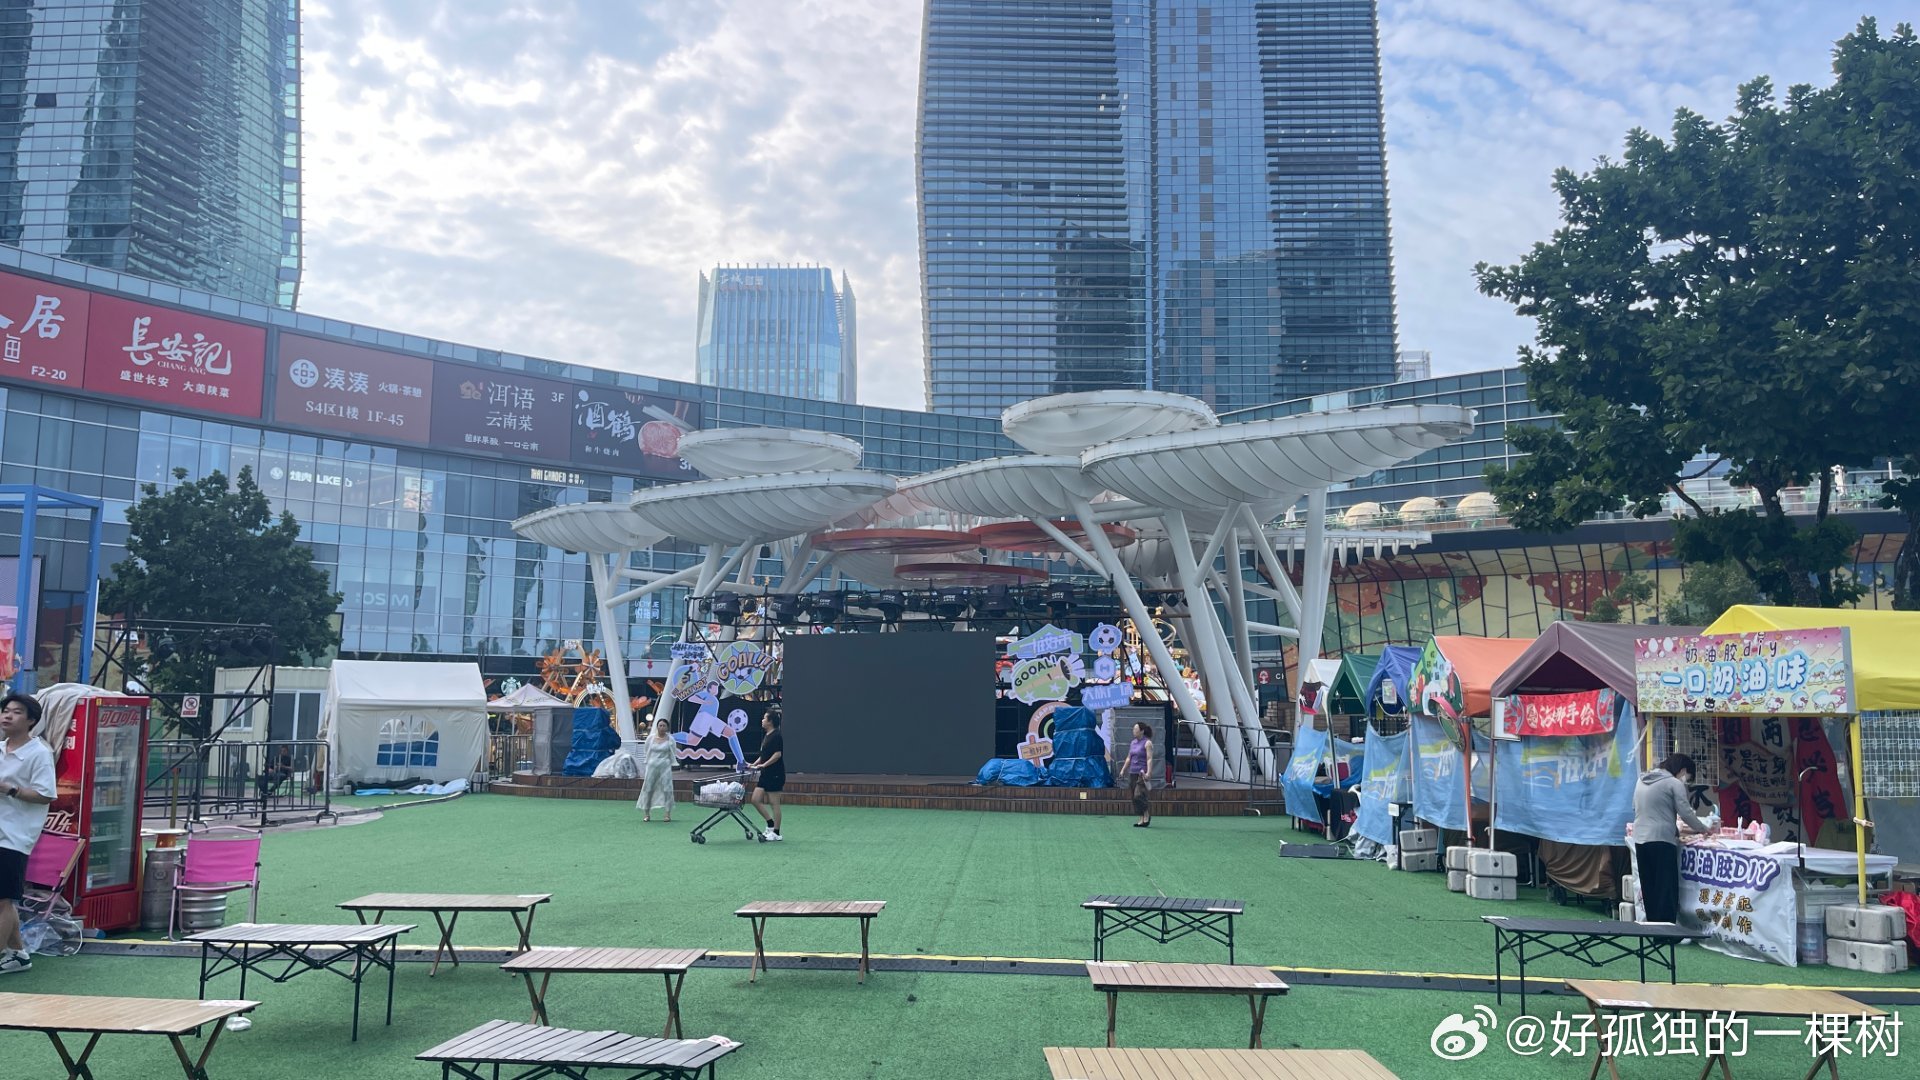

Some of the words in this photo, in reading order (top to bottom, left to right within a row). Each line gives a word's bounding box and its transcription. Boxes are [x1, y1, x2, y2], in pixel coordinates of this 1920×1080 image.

[31, 365, 67, 380] F2-20
[157, 361, 186, 371] CHANG
[188, 367, 206, 375] ANG
[119, 370, 169, 387] 盛世长安
[183, 381, 230, 398] 大美陕菜
[487, 381, 535, 410] 洱语
[551, 391, 565, 402] 3F
[305, 401, 359, 420] S4区1楼
[367, 410, 404, 426] 1F-45
[486, 411, 534, 431] 云南菜
[316, 474, 342, 486] LIKE
[362, 592, 410, 607] OSM
[717, 651, 775, 681] GOAL!!
[1014, 656, 1057, 687] GOOAL!
[1660, 653, 1806, 697] 一口奶油味
[1681, 848, 1776, 887] 奶油胶DIY
